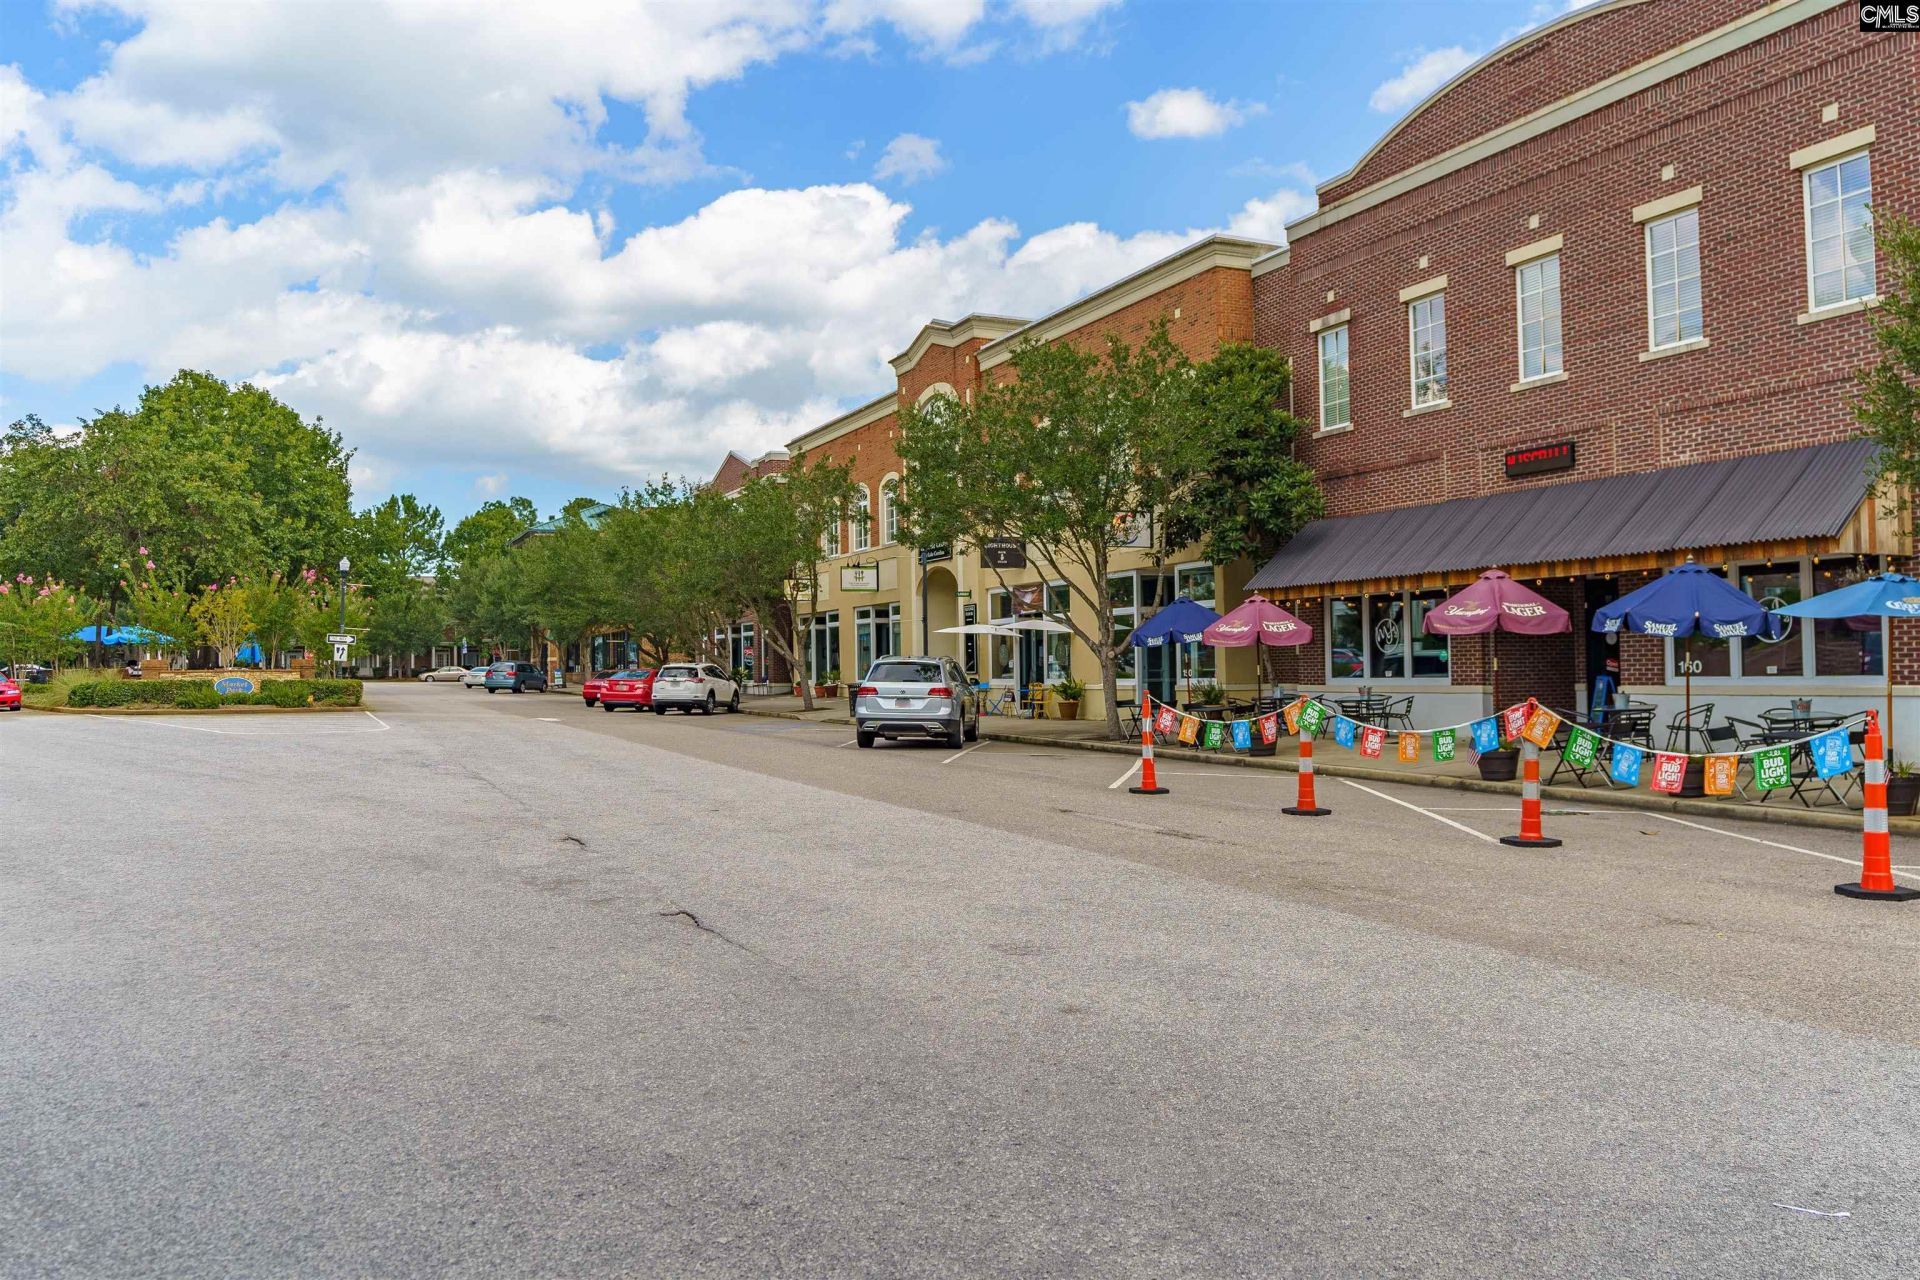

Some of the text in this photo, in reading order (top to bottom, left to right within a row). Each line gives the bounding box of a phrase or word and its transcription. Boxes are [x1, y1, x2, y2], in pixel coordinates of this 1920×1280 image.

[1501, 605, 1548, 616] LAGER
[1262, 622, 1298, 632] LAGER
[1644, 620, 1678, 631] SAMUEL
[1713, 622, 1748, 632] SAMUEL
[1645, 627, 1674, 636] ADAMS
[1719, 629, 1747, 638] ADAMS
[1307, 707, 1319, 719] BUD
[1302, 713, 1319, 725] LIGHT
[1367, 734, 1381, 743] BUD
[1438, 736, 1453, 745] BUD
[1576, 737, 1593, 749] BUD
[1365, 741, 1382, 751] LIGHT
[1437, 743, 1455, 752] LIGHT
[1571, 743, 1593, 757] LIGHT
[1661, 763, 1681, 773] BUD
[1762, 757, 1785, 769] BUD
[1658, 771, 1682, 782] LIGHT
[1761, 765, 1787, 778] LIGHT
